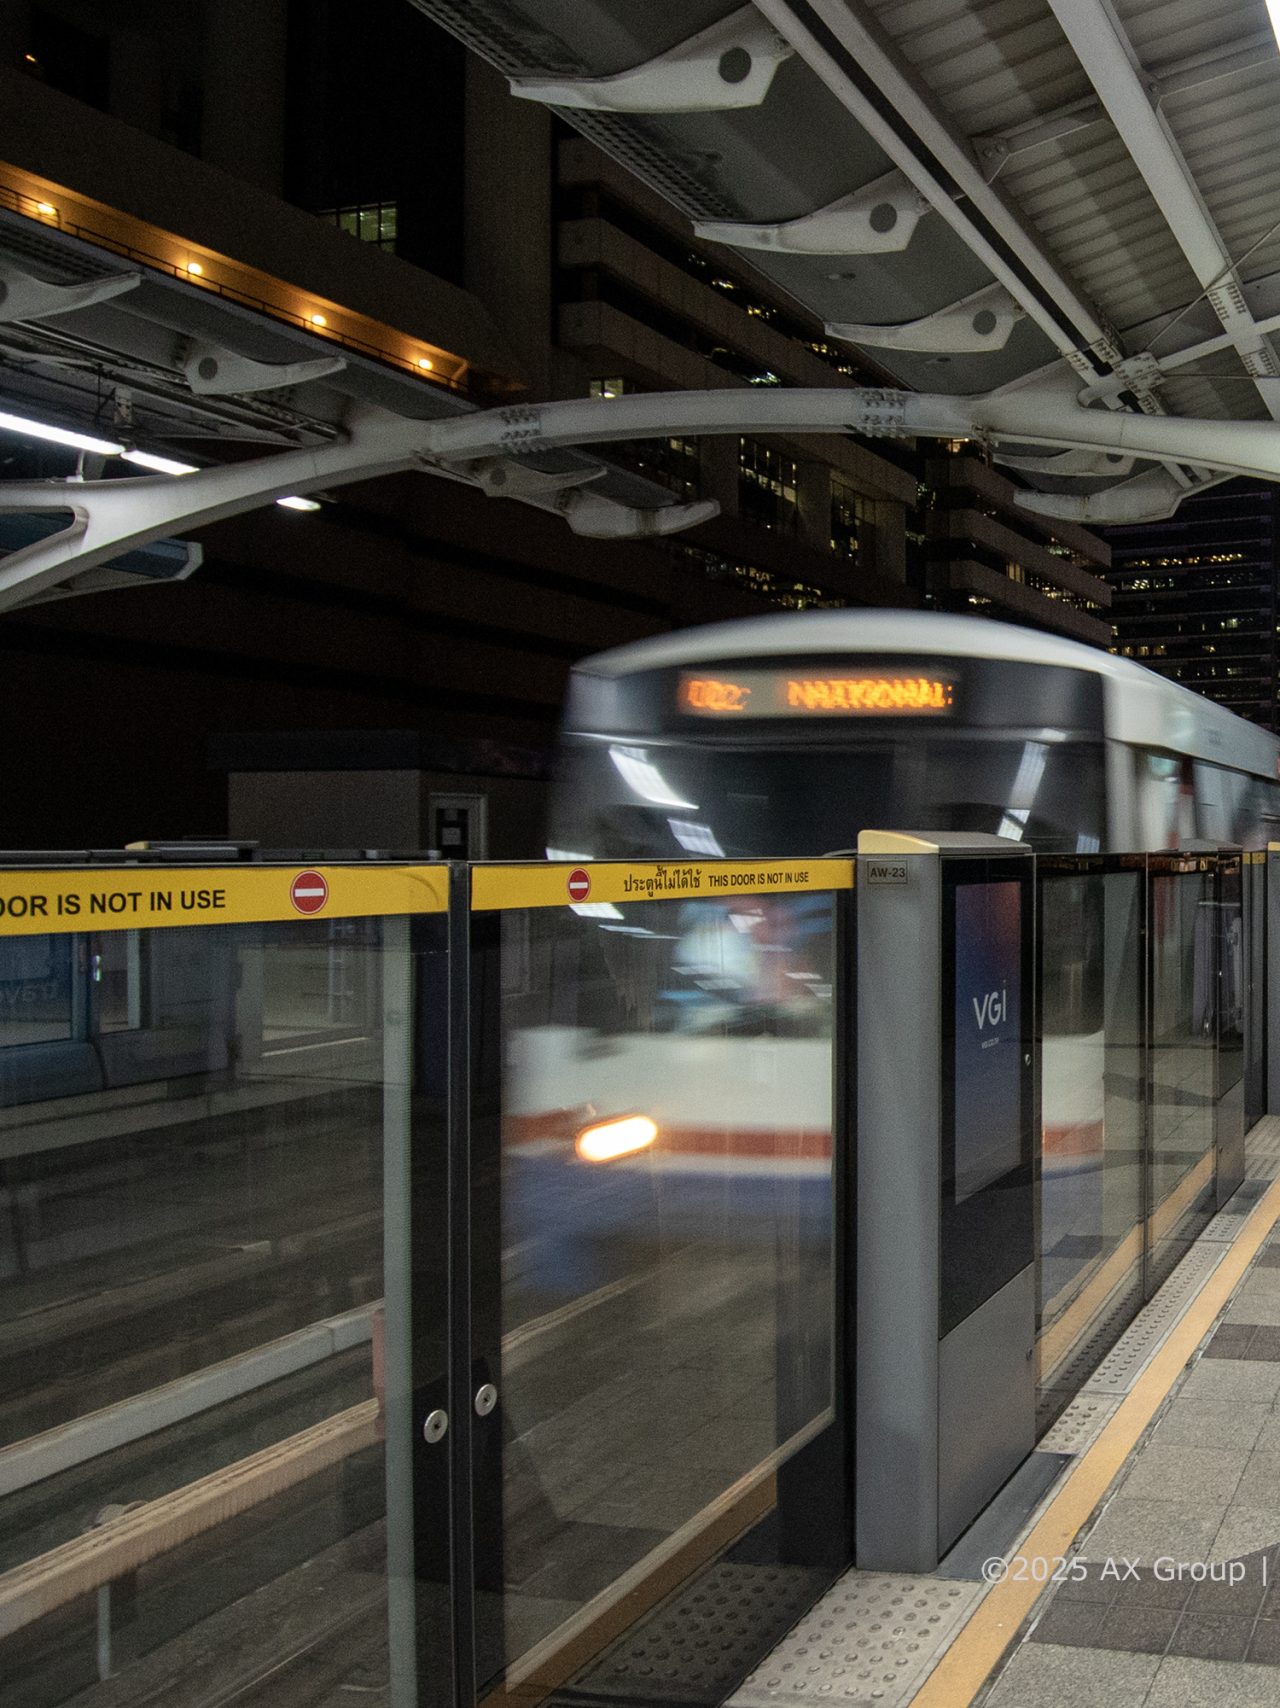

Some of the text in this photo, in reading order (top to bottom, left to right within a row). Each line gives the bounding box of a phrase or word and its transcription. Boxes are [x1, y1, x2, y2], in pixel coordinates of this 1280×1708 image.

[623, 865, 809, 898] ประตูนี้ไม่ได้ใช้ THIS DOOR IS NOT IN USE
[870, 866, 906, 879] AW-23
[0, 889, 226, 918] OOR IS NOT IN USE
